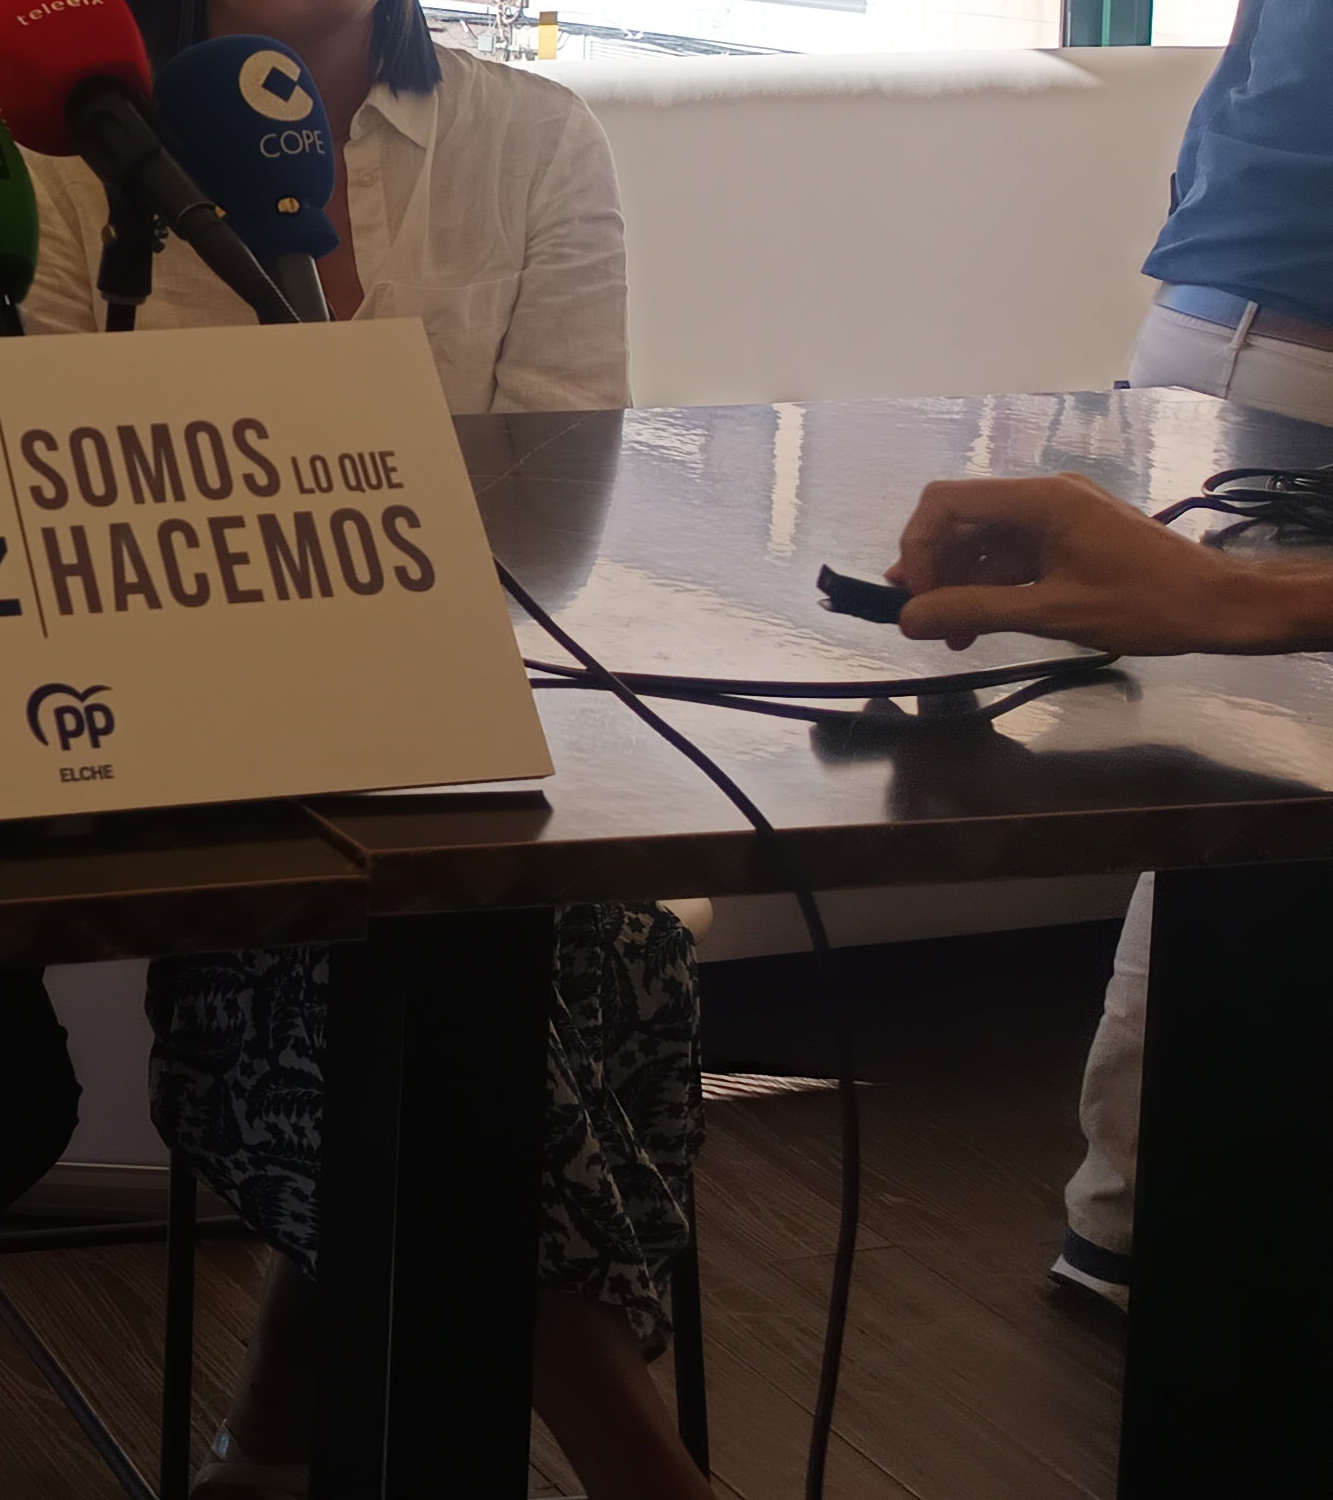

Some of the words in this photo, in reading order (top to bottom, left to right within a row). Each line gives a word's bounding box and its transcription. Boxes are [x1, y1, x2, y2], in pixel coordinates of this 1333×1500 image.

[260, 129, 326, 158] COPE
[20, 417, 282, 511] SOMOS
[291, 454, 334, 495] LO
[338, 450, 405, 494] QUE
[41, 504, 436, 617] HACEMOS
[59, 764, 115, 783] ELCHE
